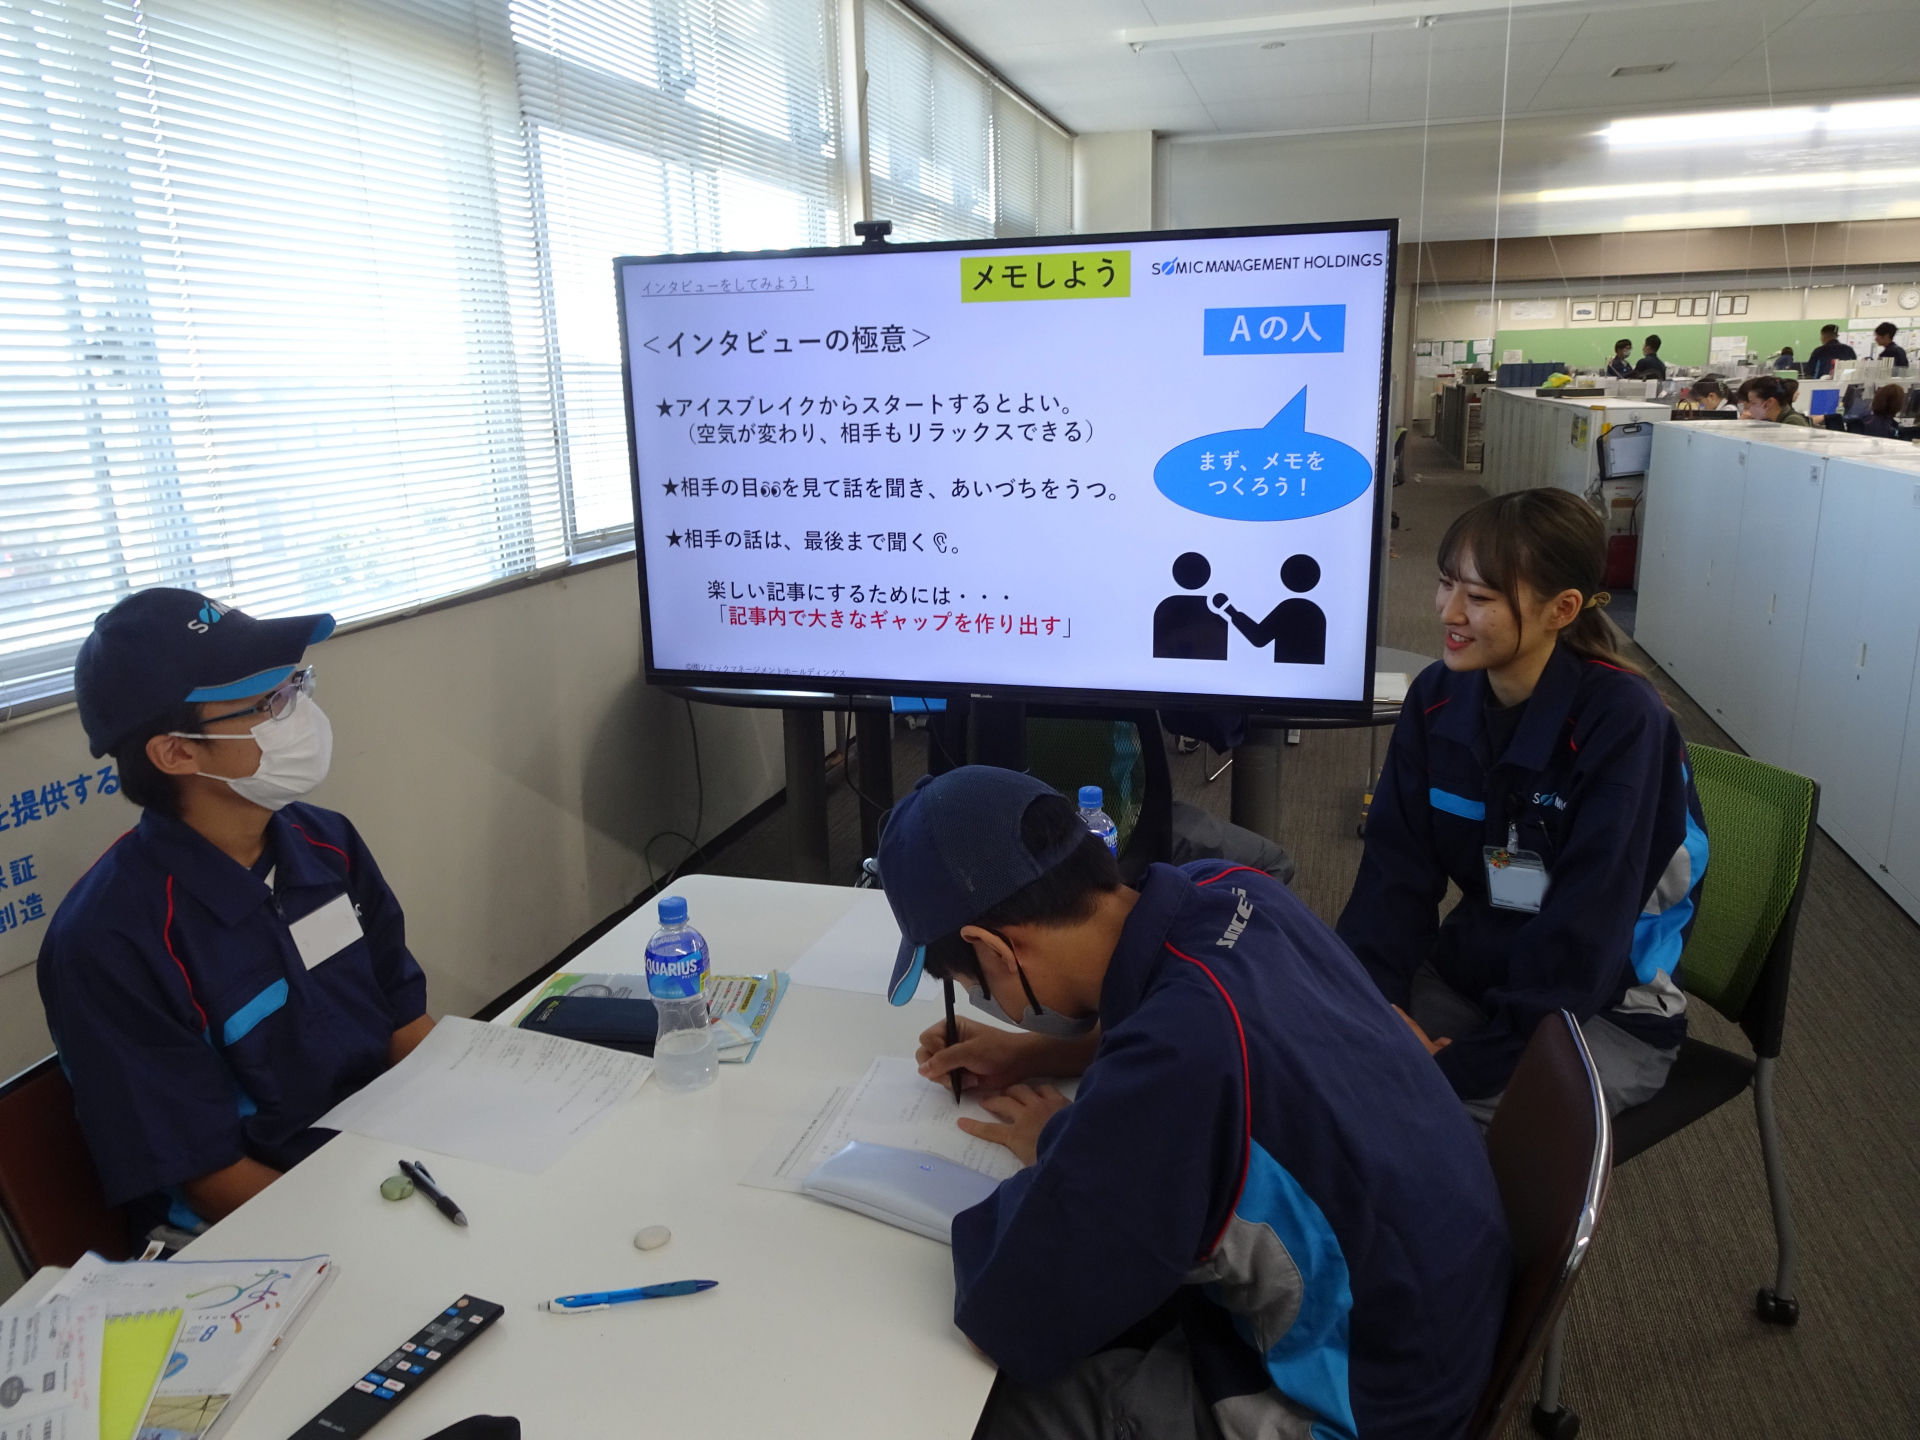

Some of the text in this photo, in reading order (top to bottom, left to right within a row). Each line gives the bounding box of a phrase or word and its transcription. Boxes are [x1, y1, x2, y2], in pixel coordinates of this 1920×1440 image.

[972, 258, 1118, 291] メモしよう
[1151, 253, 1383, 275] SOMIC MANAGEMENT HOLDINGS
[641, 276, 812, 294] インタビューをしてみよう！
[1229, 312, 1322, 343] Aの人
[1199, 451, 1325, 472] まず、メモを
[1208, 477, 1308, 497] つくろう！
[718, 604, 1072, 640] 「記事内で大きなギャップを作り出す」
[645, 958, 698, 977] QUARIUS
[199, 1325, 219, 1342] 8
